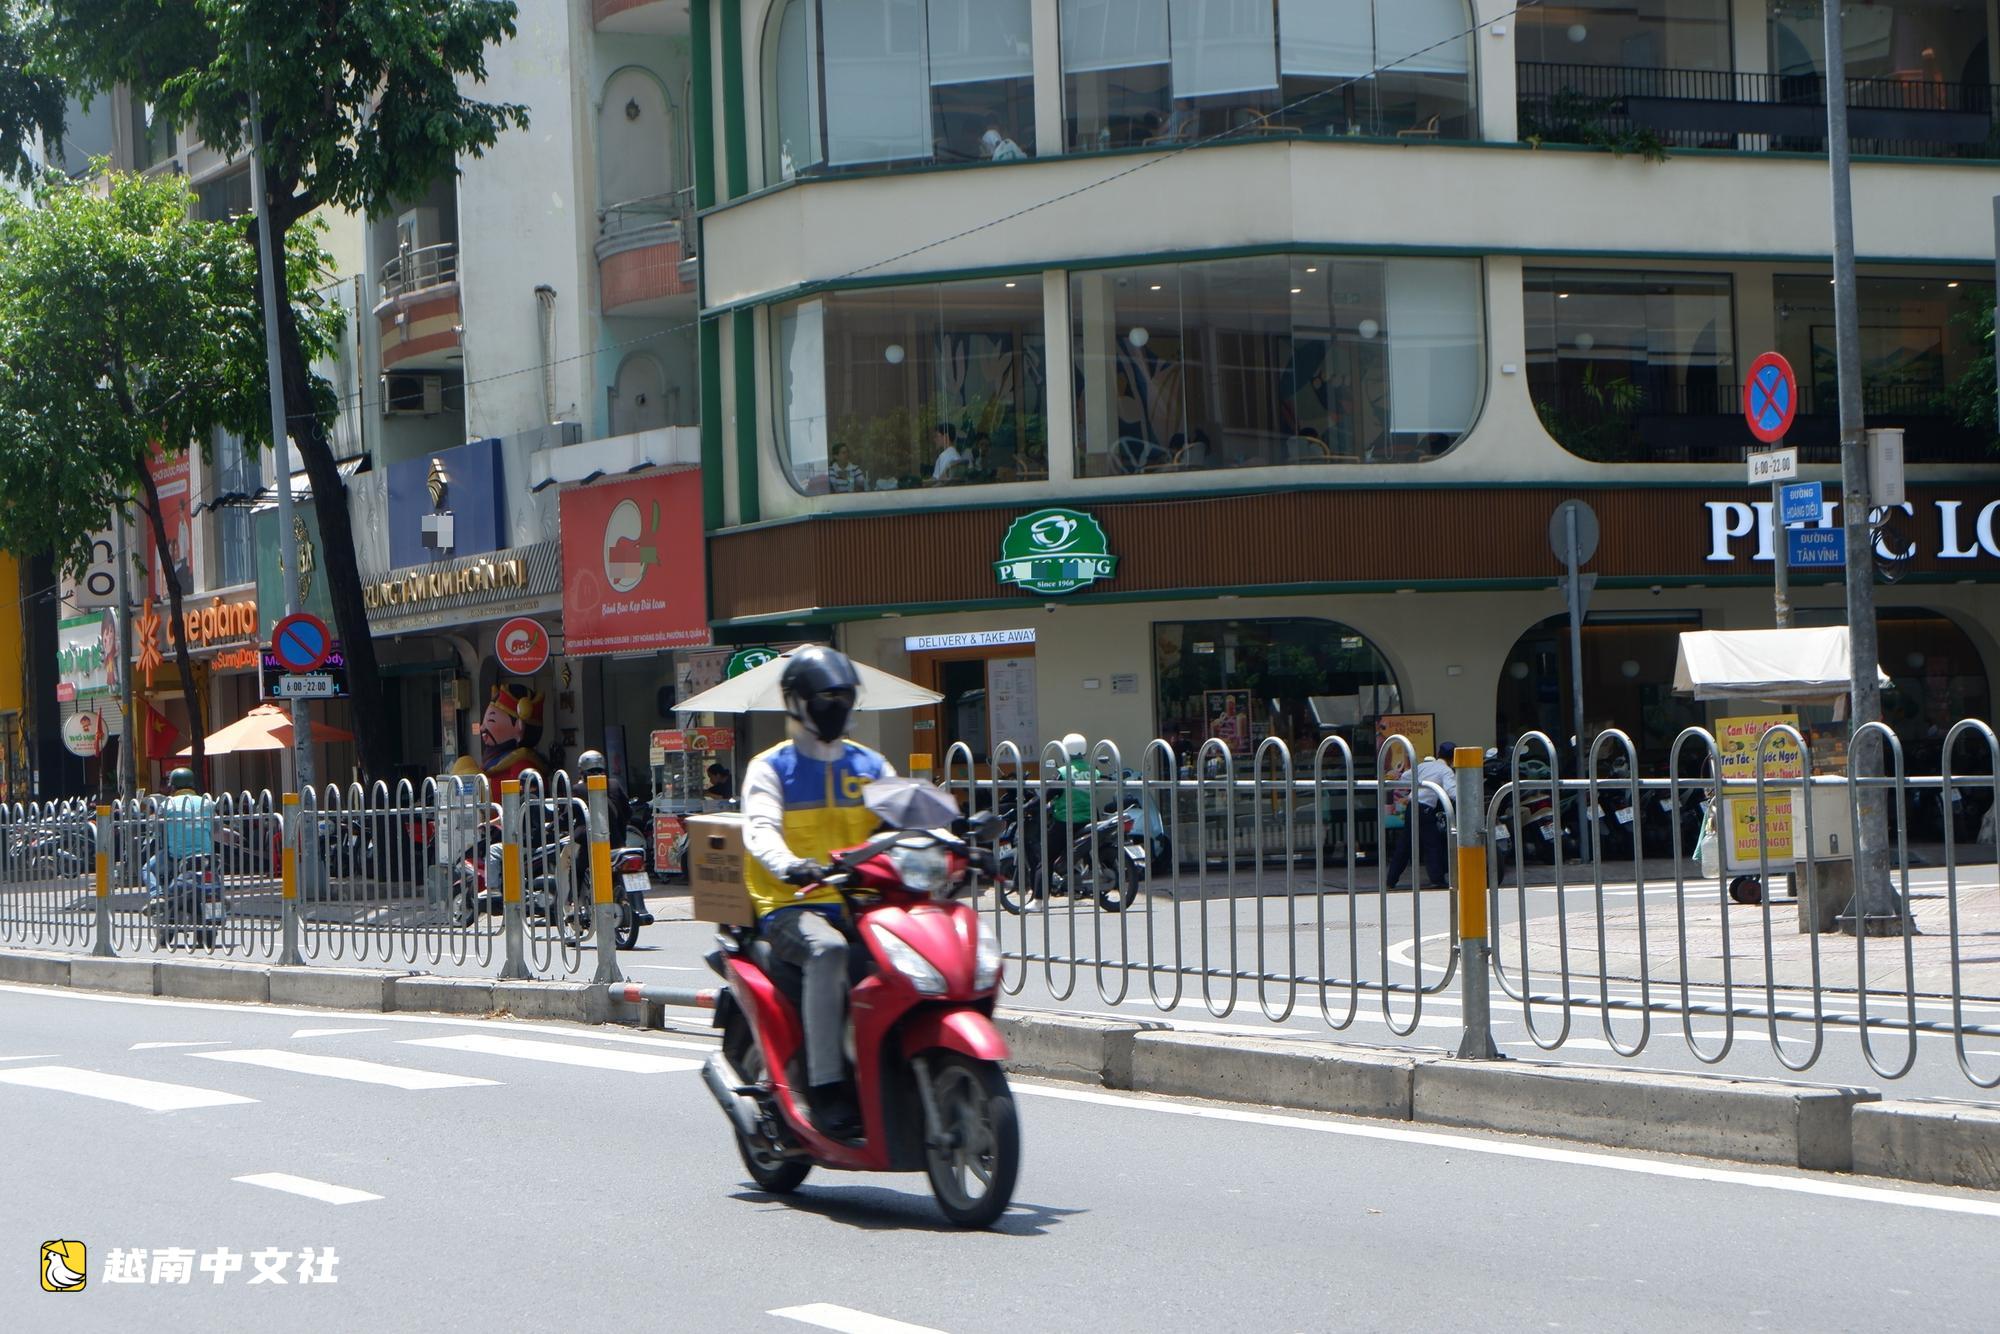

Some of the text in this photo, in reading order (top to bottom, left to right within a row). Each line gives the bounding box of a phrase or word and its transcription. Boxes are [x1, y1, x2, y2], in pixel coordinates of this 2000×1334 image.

[1789, 488, 1814, 500] ĐƯỜNG
[1704, 501, 1917, 561] PC
[1800, 532, 1834, 544] ĐƯỜNG
[1796, 548, 1816, 562] TÂN
[364, 580, 402, 609] RUNG
[428, 573, 452, 598] KIM
[499, 559, 528, 590] PNJ
[918, 630, 1036, 649] DELIVERY & TAKE AWAY
[325, 653, 344, 666] ody
[1073, 770, 1092, 780] Gra
[1748, 822, 1770, 833] CA
[1738, 836, 1760, 849] NƯỚ
